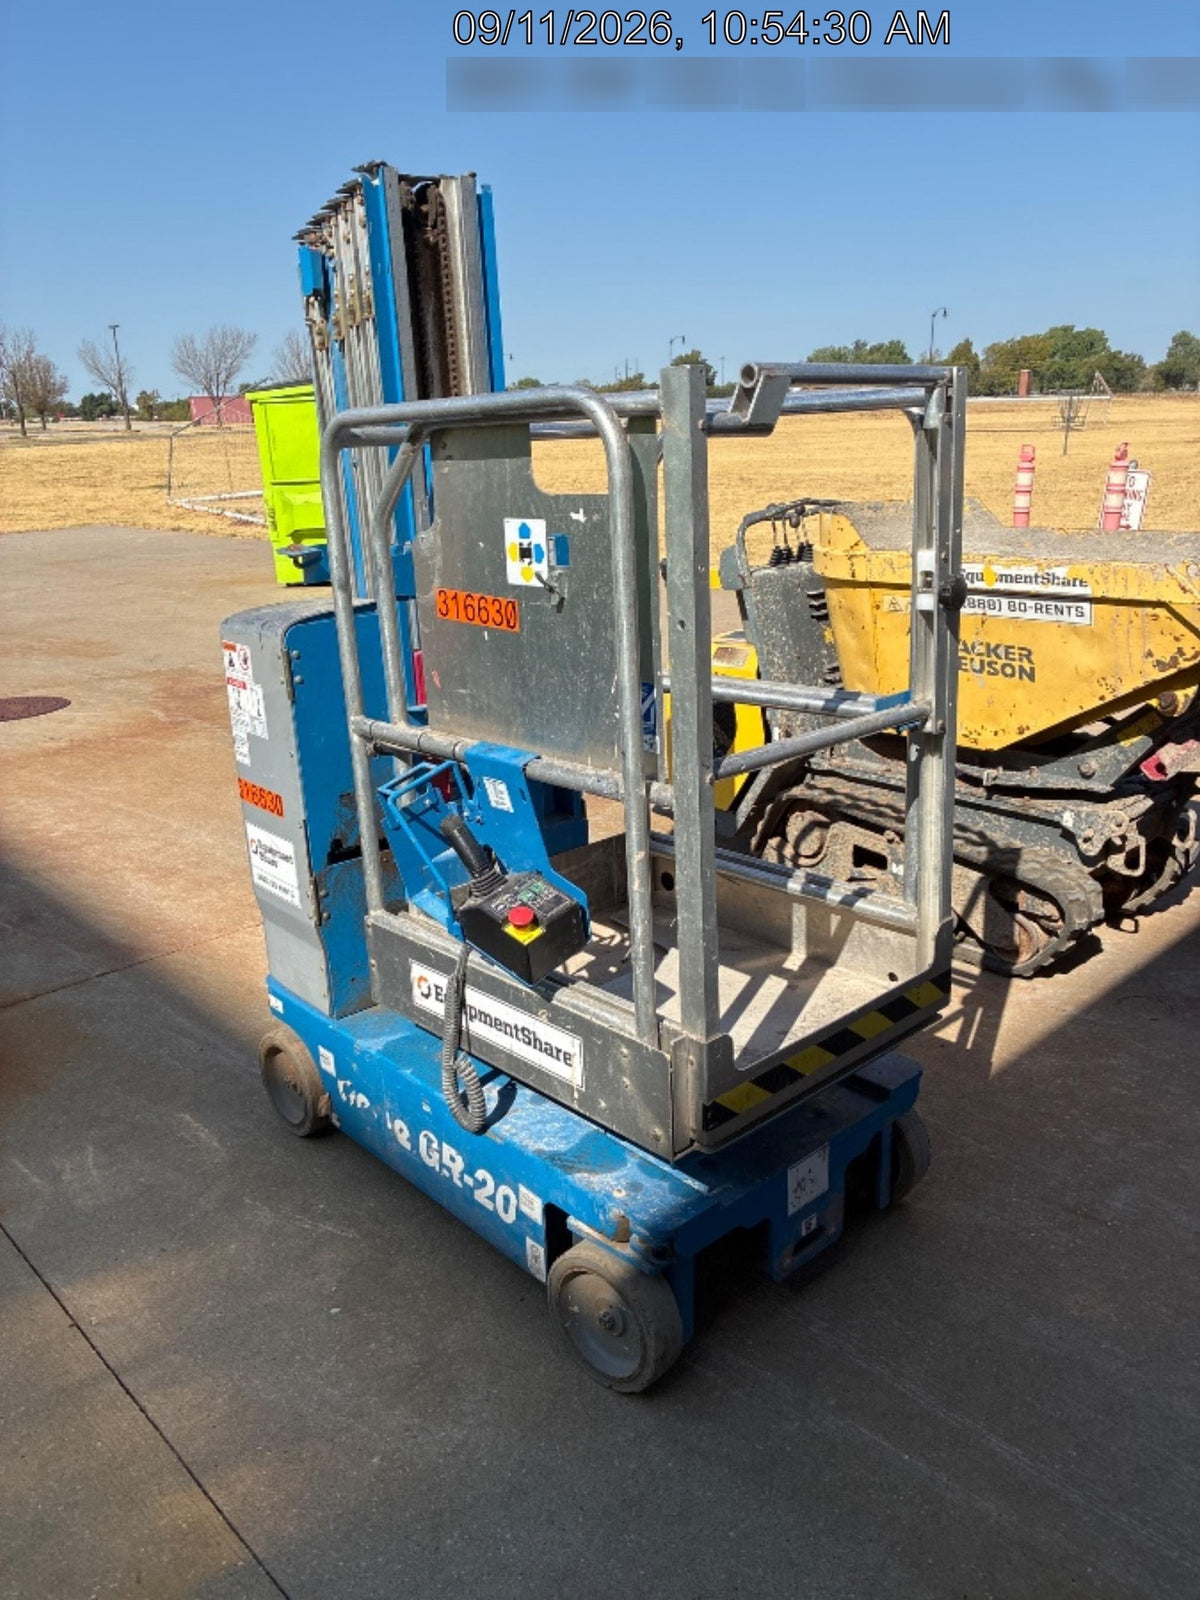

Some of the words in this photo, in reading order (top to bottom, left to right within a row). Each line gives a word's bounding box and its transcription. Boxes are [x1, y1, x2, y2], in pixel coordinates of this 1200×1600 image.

[438, 589, 518, 630] 316630
[958, 640, 1036, 665] ACKER
[958, 656, 1036, 683] EUSON
[433, 983, 573, 1068] EpmentShare
[418, 1130, 518, 1224] GR-20
